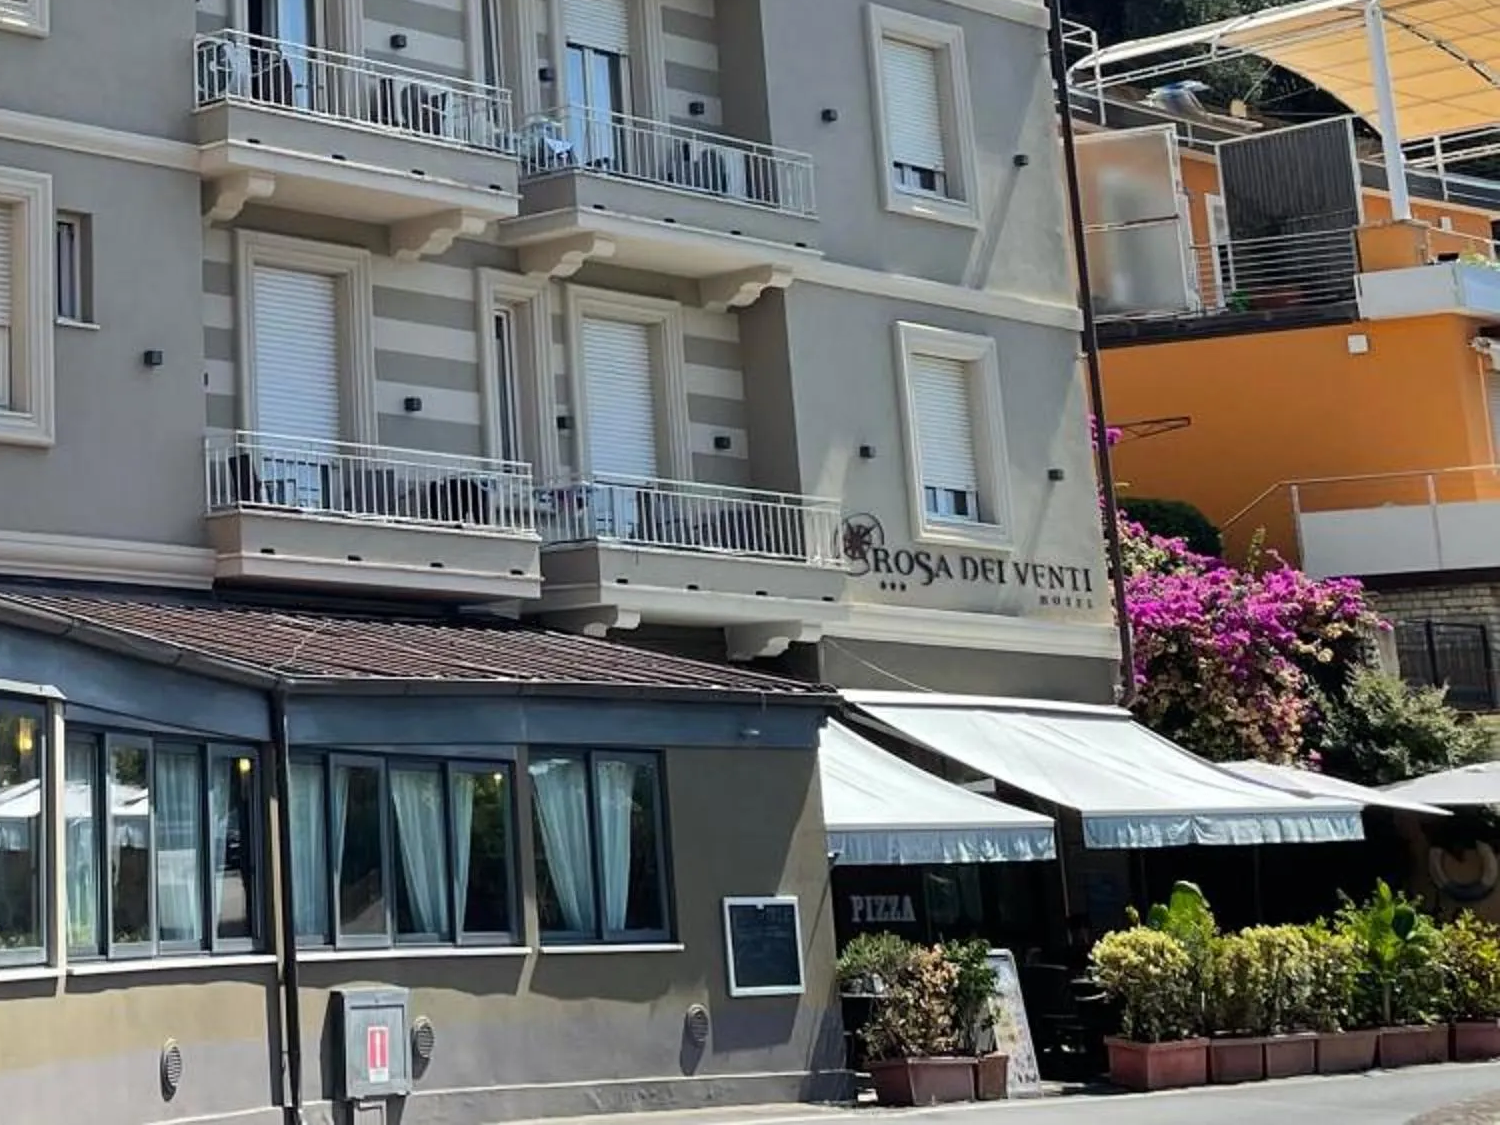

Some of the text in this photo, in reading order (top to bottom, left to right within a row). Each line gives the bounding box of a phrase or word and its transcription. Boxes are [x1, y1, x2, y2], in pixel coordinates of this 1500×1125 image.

[872, 547, 1093, 593] ROSA DEI VENTI
[1039, 595, 1094, 610] HOTEL
[849, 895, 917, 923] PIZZA
